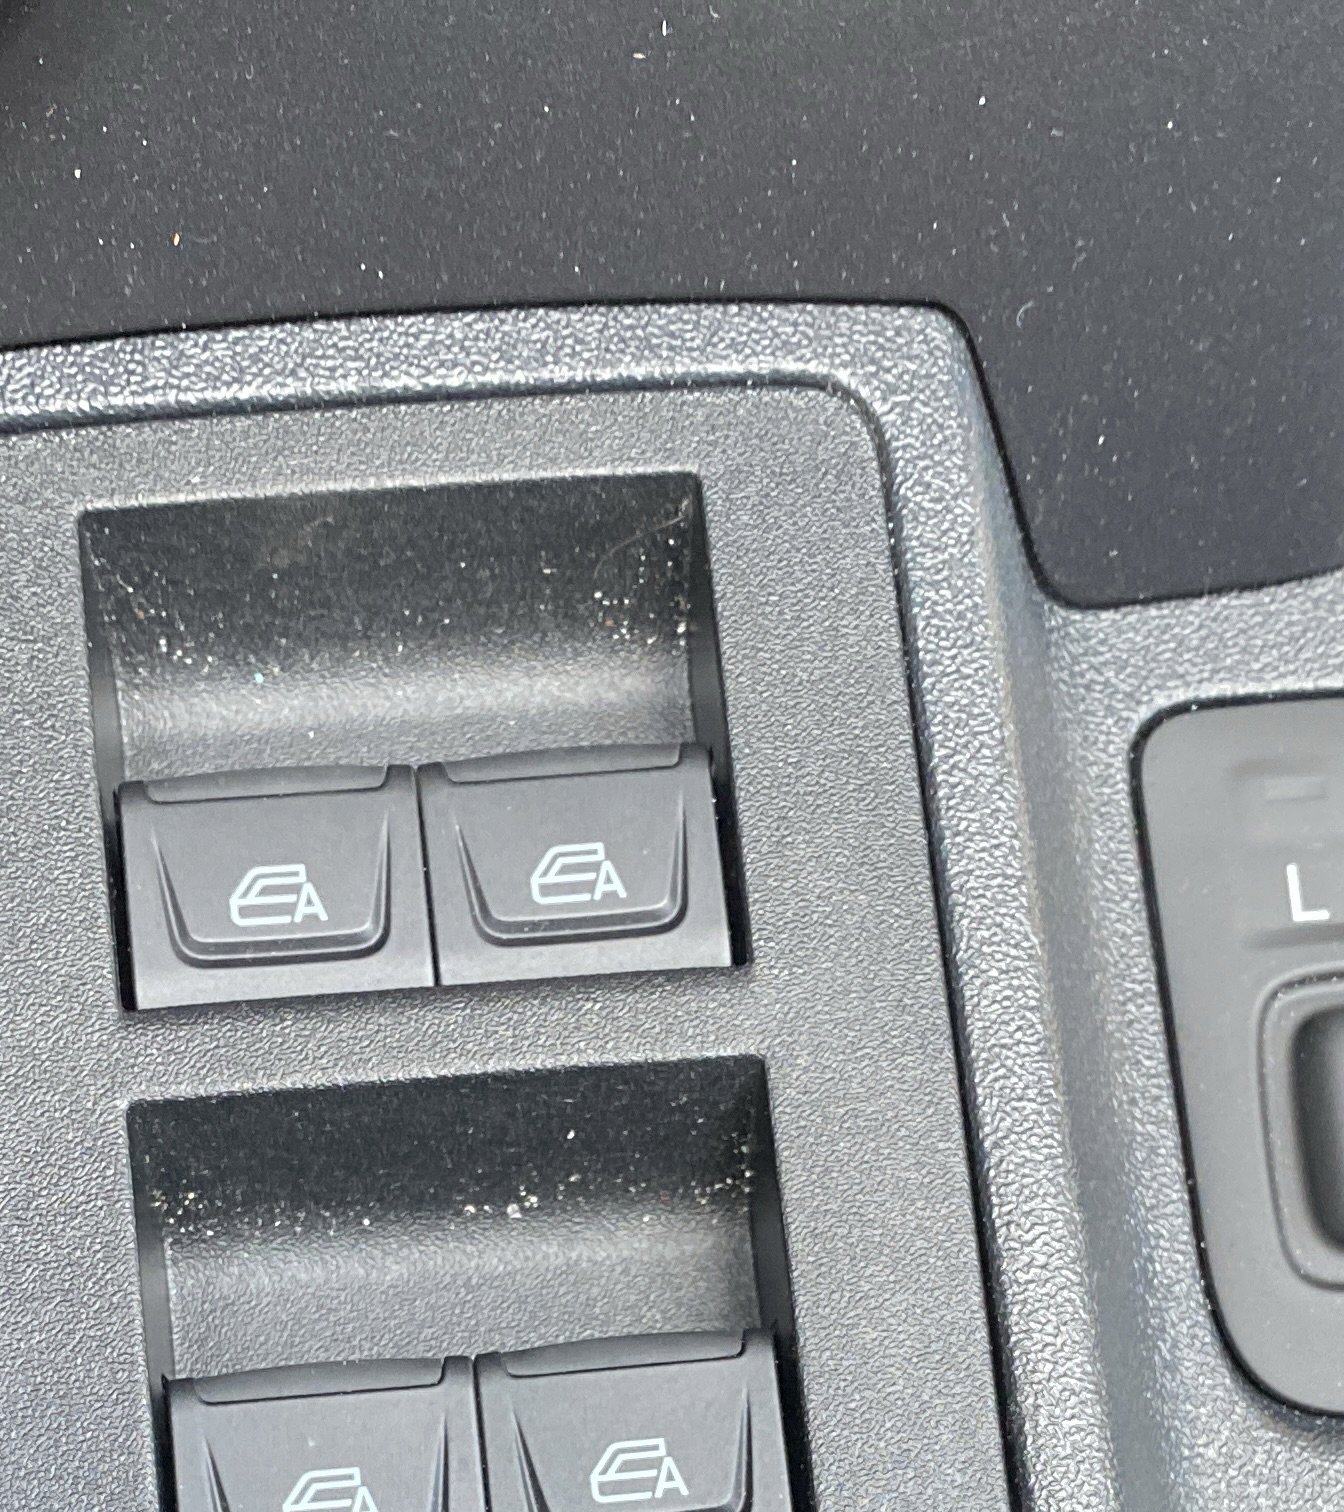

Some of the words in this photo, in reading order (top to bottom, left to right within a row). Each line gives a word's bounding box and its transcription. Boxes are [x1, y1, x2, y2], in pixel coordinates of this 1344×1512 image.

[594, 861, 628, 900] A
[1286, 862, 1331, 922] L
[293, 883, 329, 923] A
[655, 1457, 690, 1499] A
